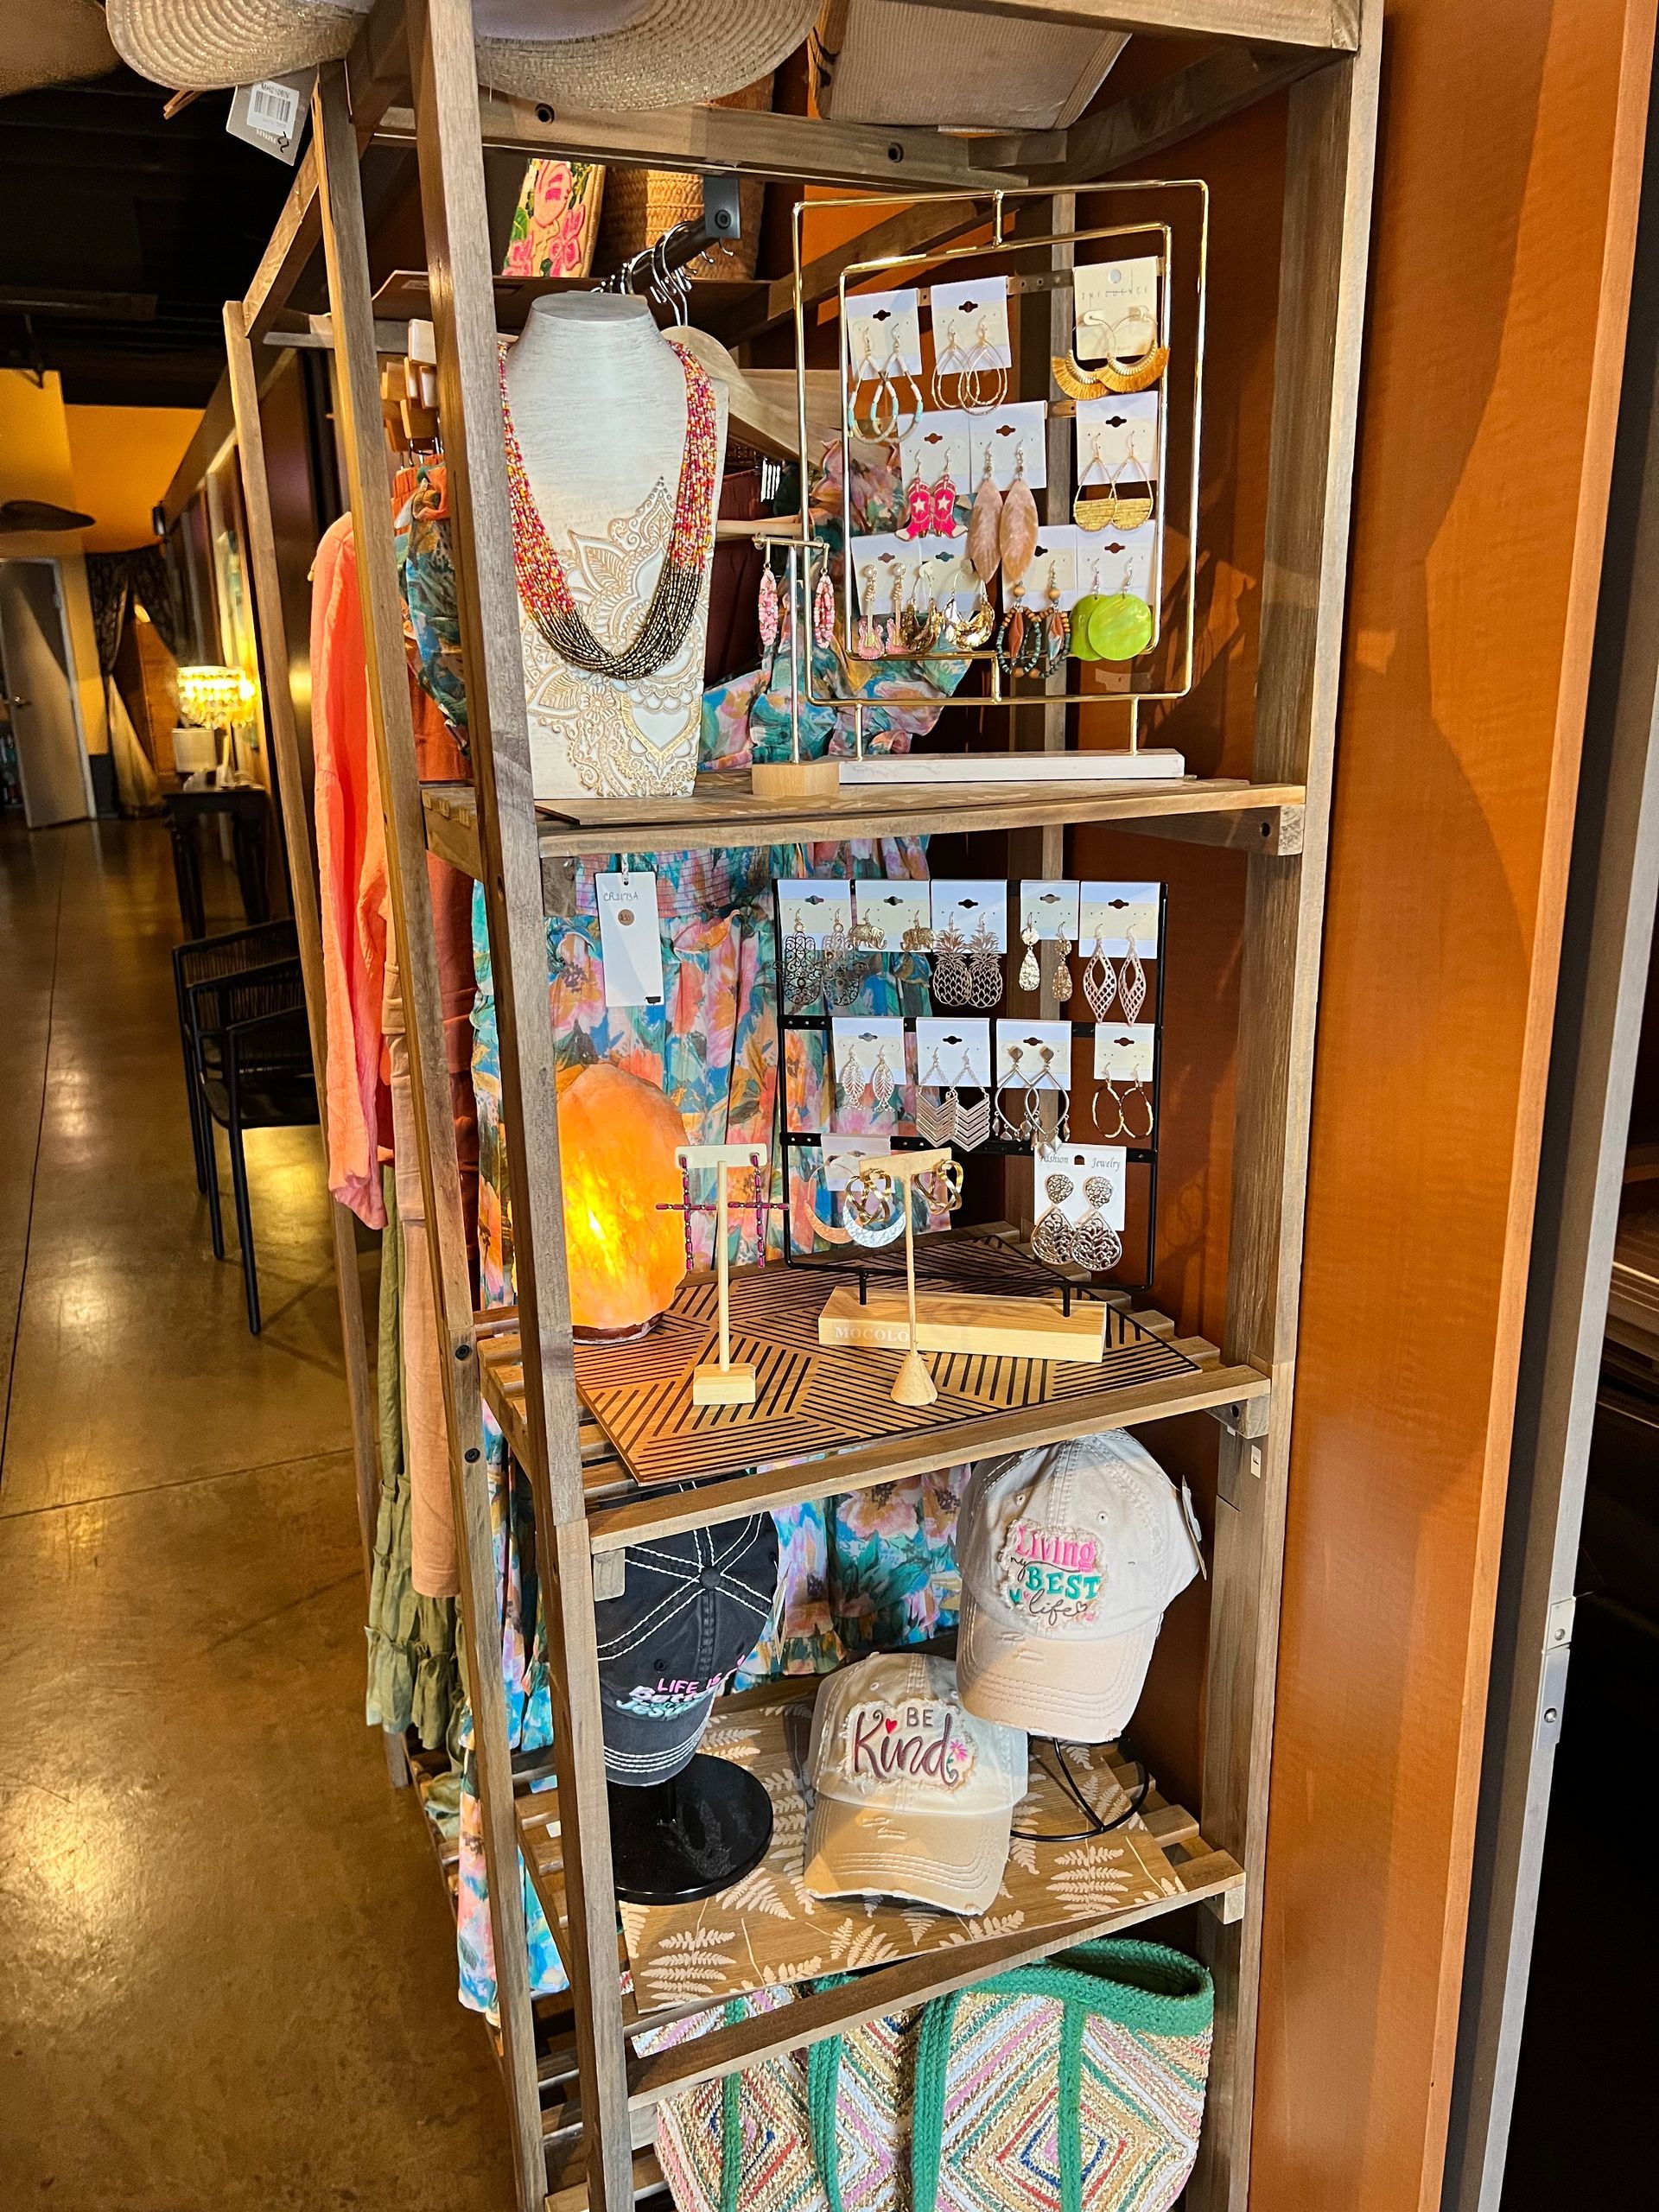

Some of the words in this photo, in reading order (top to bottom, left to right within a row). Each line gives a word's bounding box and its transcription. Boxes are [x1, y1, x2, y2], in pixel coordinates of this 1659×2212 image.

[1082, 286, 1147, 300] INFLUENCE
[1091, 1157, 1121, 1172] Jewelry
[835, 1326, 910, 1343] MOCOLO
[1025, 1565, 1102, 1601] BEST
[1029, 1589, 1075, 1625] life
[657, 1677, 700, 1694] LIFE
[907, 1707, 934, 1727] BE
[853, 1709, 958, 1787] Kind
